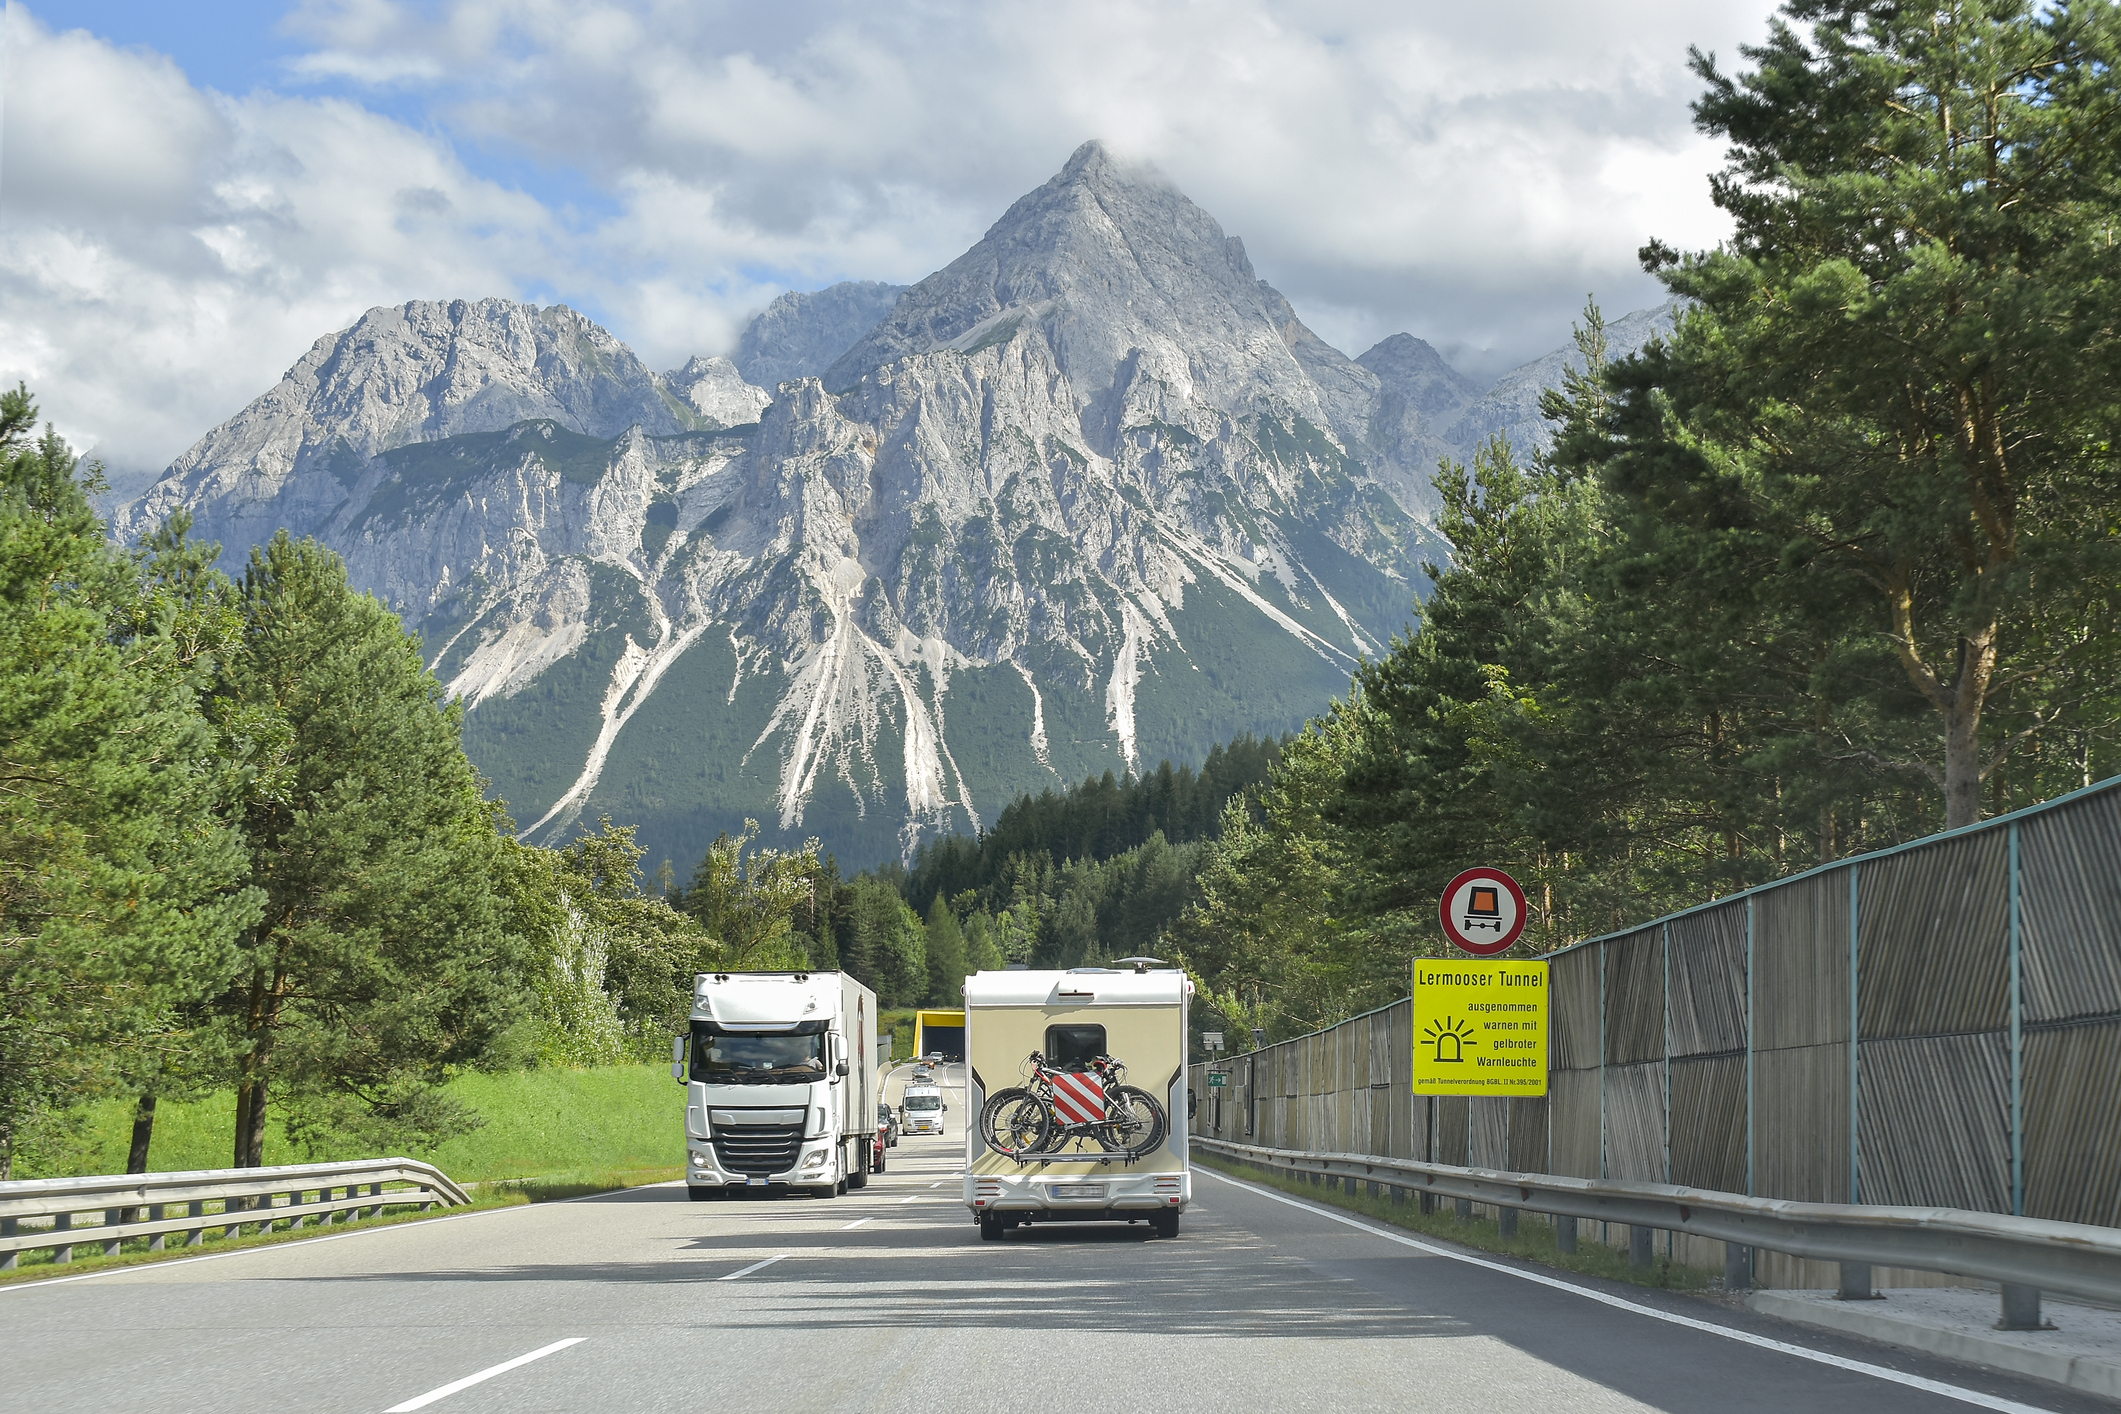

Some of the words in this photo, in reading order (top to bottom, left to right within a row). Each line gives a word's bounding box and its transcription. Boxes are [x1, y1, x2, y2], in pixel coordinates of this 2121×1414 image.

[1420, 970, 1493, 986] Lermooser
[1499, 971, 1543, 987] Tunnel
[1468, 1003, 1538, 1013] ausgenommen
[1483, 1021, 1519, 1030] warnen
[1522, 1020, 1537, 1030] mit
[1493, 1038, 1537, 1050] gelbroter
[1476, 1056, 1537, 1067] Warnleuchte
[1438, 1078, 1485, 1086] Tunnelverordnung
